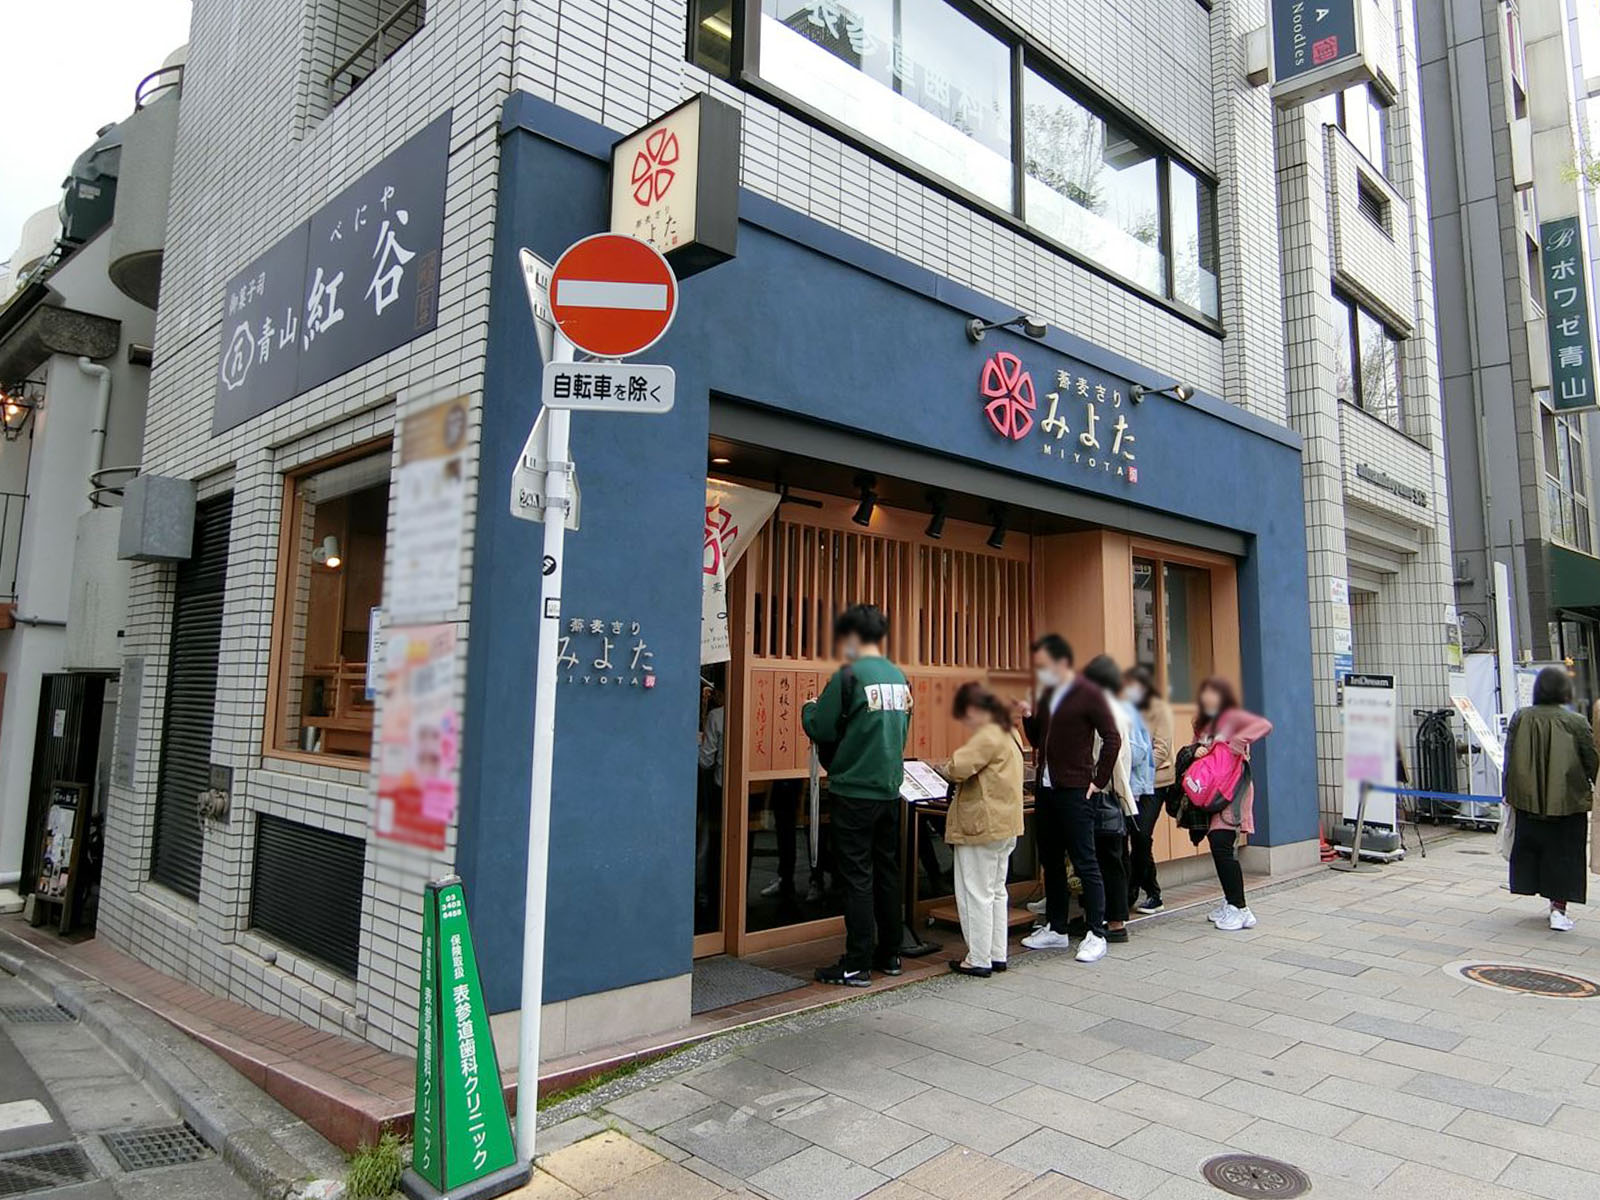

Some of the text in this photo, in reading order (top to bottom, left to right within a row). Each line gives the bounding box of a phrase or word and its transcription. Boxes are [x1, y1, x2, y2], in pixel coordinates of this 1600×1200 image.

[1292, 2, 1306, 66] Noodles
[330, 185, 395, 242] べにや
[1551, 257, 1587, 400] ボワゼ青山
[553, 372, 661, 402] 自転車を除く
[1056, 369, 1121, 408] 蕎麦きり
[1040, 392, 1136, 461] みよた
[1043, 443, 1124, 477] MIYOTA
[569, 618, 640, 635] 蕎麦きり
[556, 636, 654, 670] みよた
[557, 675, 638, 685] IYOTA
[450, 934, 465, 980] 保険取扱
[452, 984, 488, 1170] 表参道歯科クリニック
